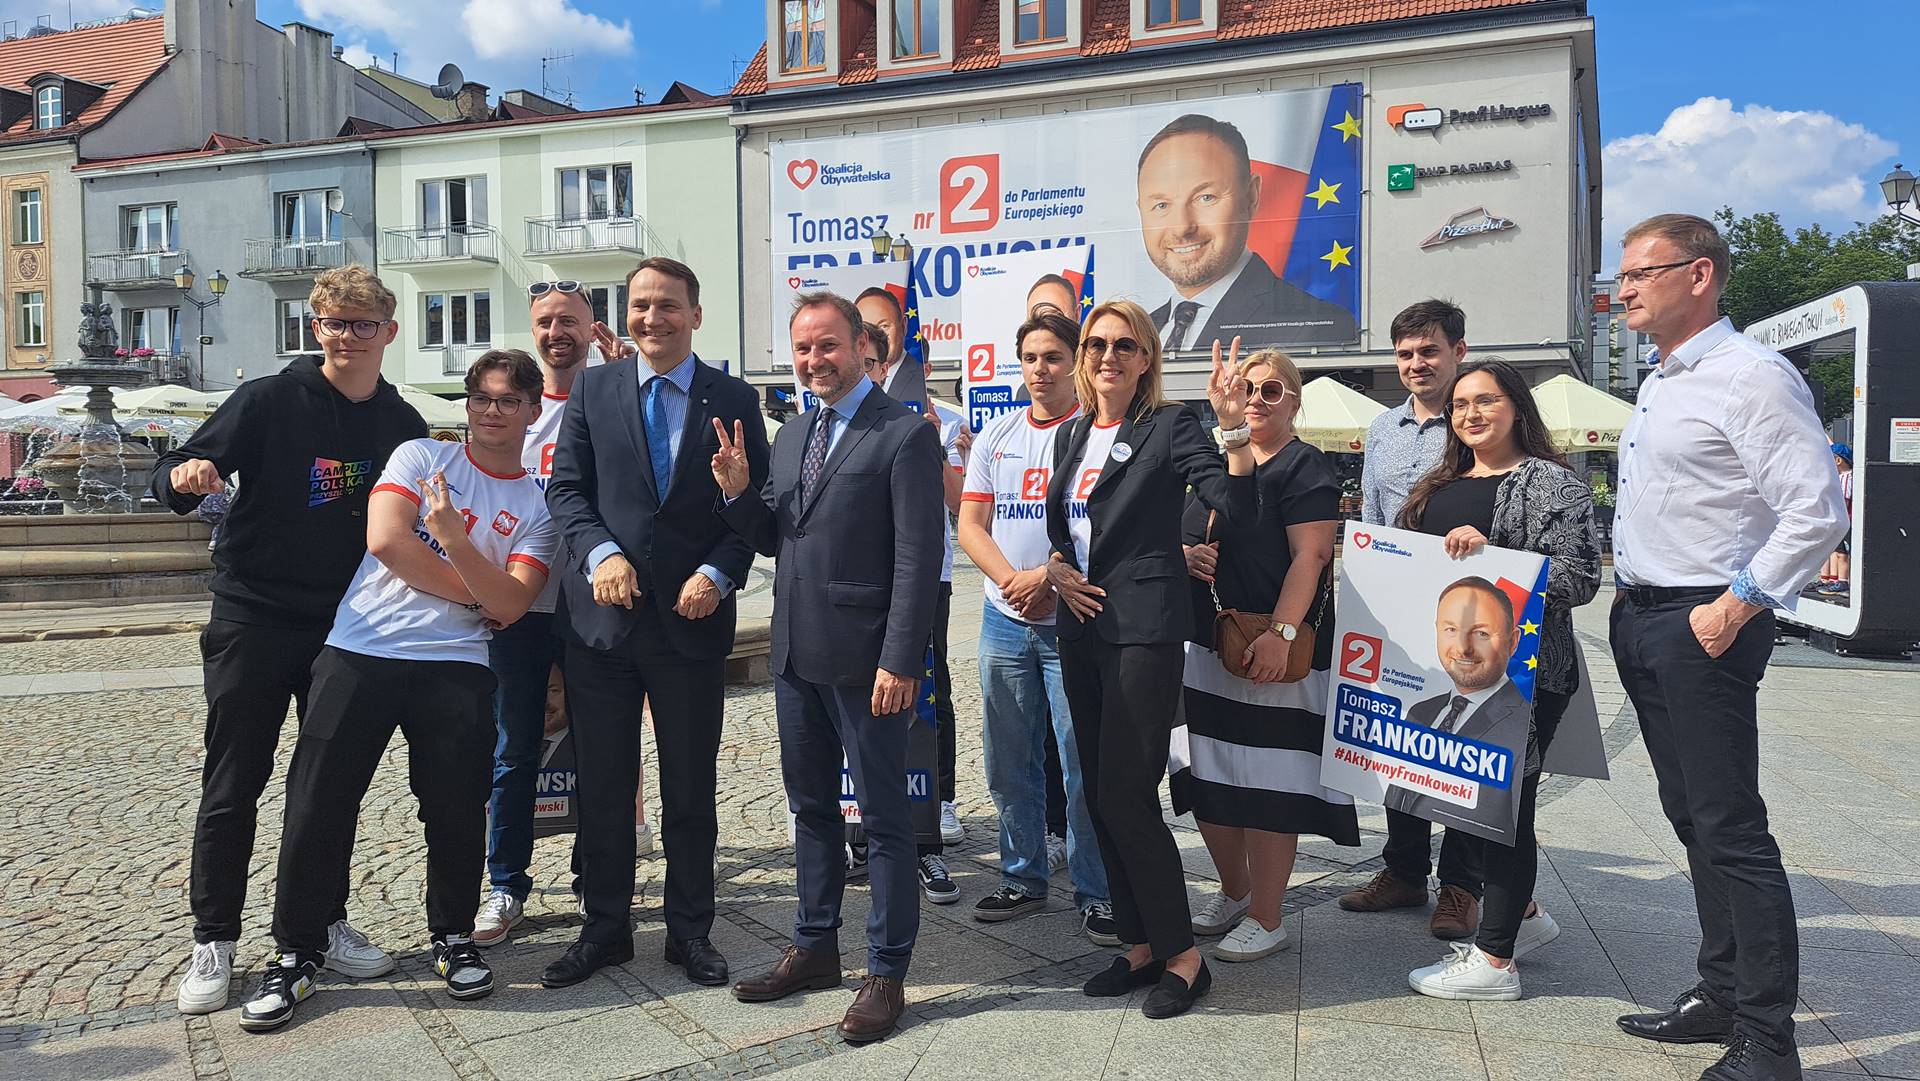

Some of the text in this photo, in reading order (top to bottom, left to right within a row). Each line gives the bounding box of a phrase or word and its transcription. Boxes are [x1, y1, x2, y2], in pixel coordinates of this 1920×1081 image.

[820, 162, 863, 175] Koalicja
[1450, 159, 1512, 175] PARIBAS
[820, 170, 891, 186] Obywatelska
[913, 164, 990, 231] nr 2
[1004, 185, 1086, 203] do Parlamentu
[1004, 203, 1084, 221] Europejskiego
[787, 212, 889, 244] Tomasz
[1438, 218, 1506, 240] Pizza Hut
[972, 348, 991, 377] 2
[971, 389, 1009, 403] Tomasz
[313, 463, 368, 478] CAMPUS
[311, 475, 364, 493] POLSKA
[1027, 472, 1045, 497] 2
[1346, 638, 1375, 678] 2
[1381, 674, 1424, 691] Europejskiego
[1390, 668, 1425, 684] Parlamentu
[1342, 686, 1396, 718] Tomasz
[1337, 710, 1508, 782] FRANKOWSKI
[1333, 746, 1473, 801] #AktywnyFrankowski
